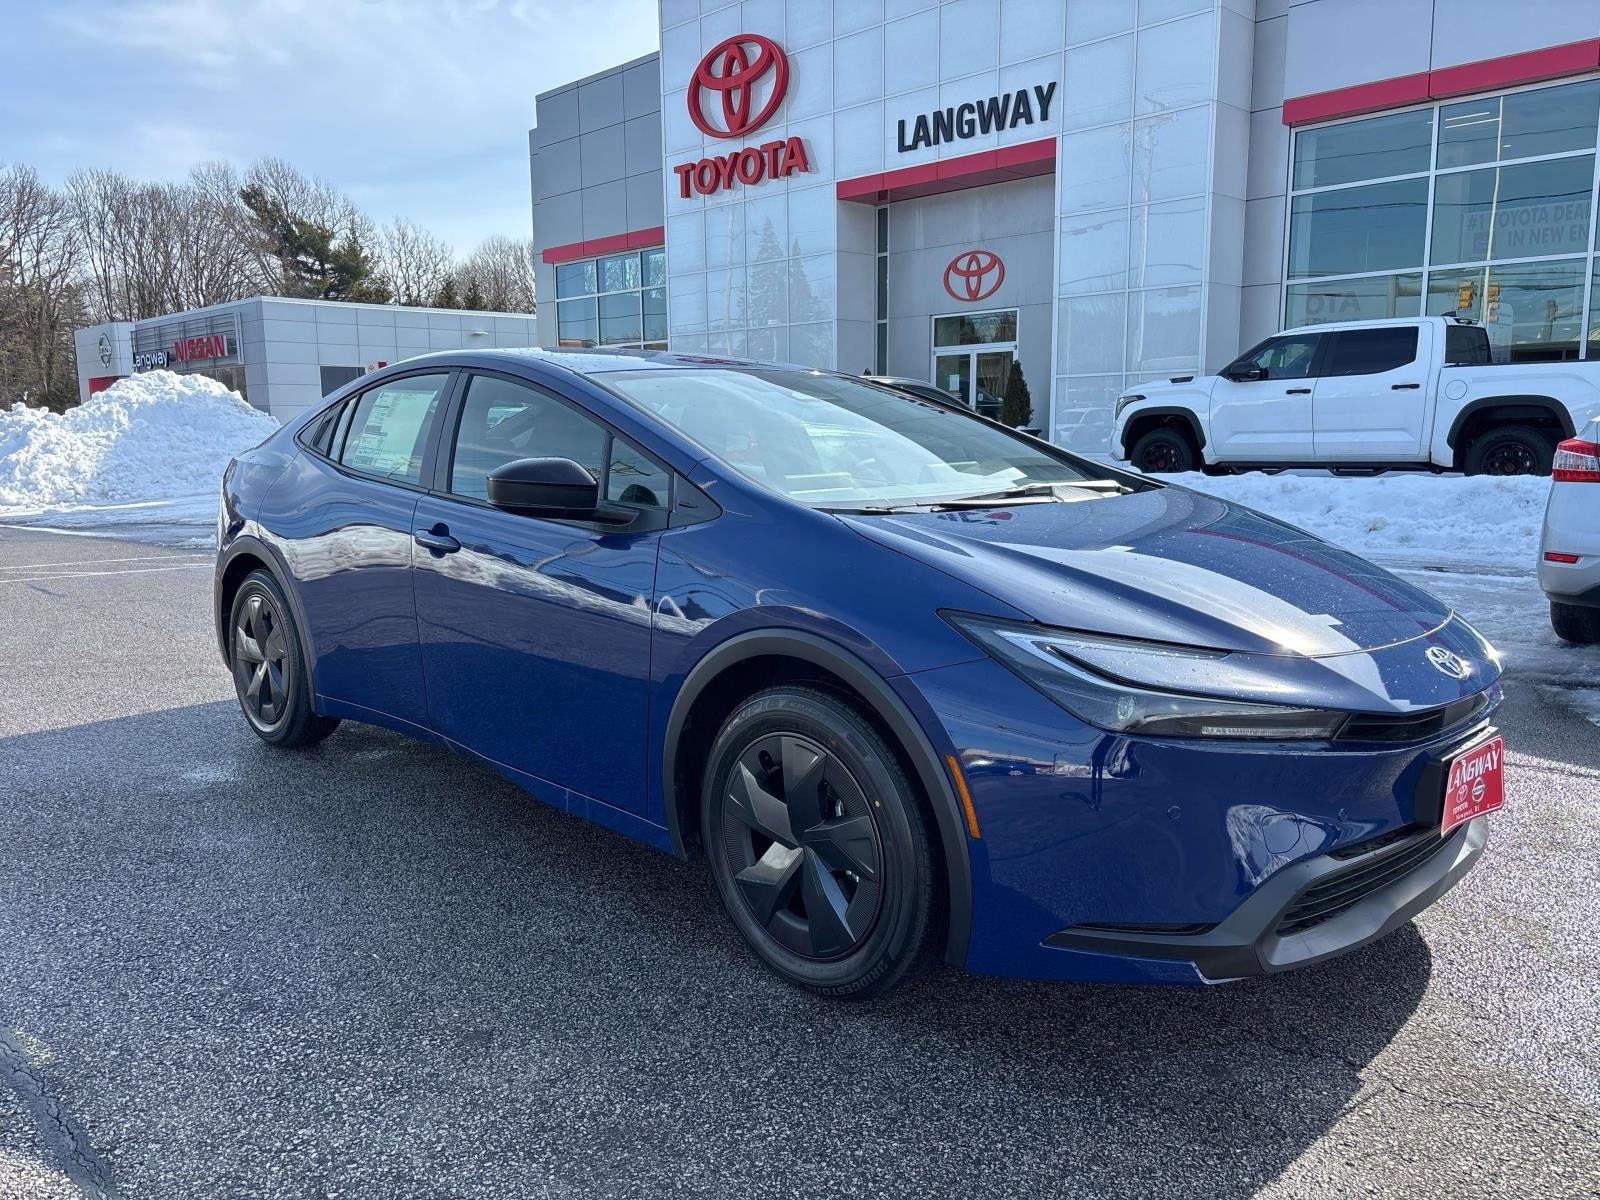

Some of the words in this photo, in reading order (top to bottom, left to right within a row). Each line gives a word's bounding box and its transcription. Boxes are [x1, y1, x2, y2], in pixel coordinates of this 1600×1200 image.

[898, 82, 1056, 153] LANGWAY
[674, 136, 809, 198] TOYOTA
[1492, 208, 1548, 227] OYOTA
[1507, 229, 1523, 247] IN
[1529, 226, 1564, 245] NEW
[133, 351, 167, 369] Langway
[173, 335, 227, 361] NISSAN
[1447, 748, 1500, 793] LANGWAY
